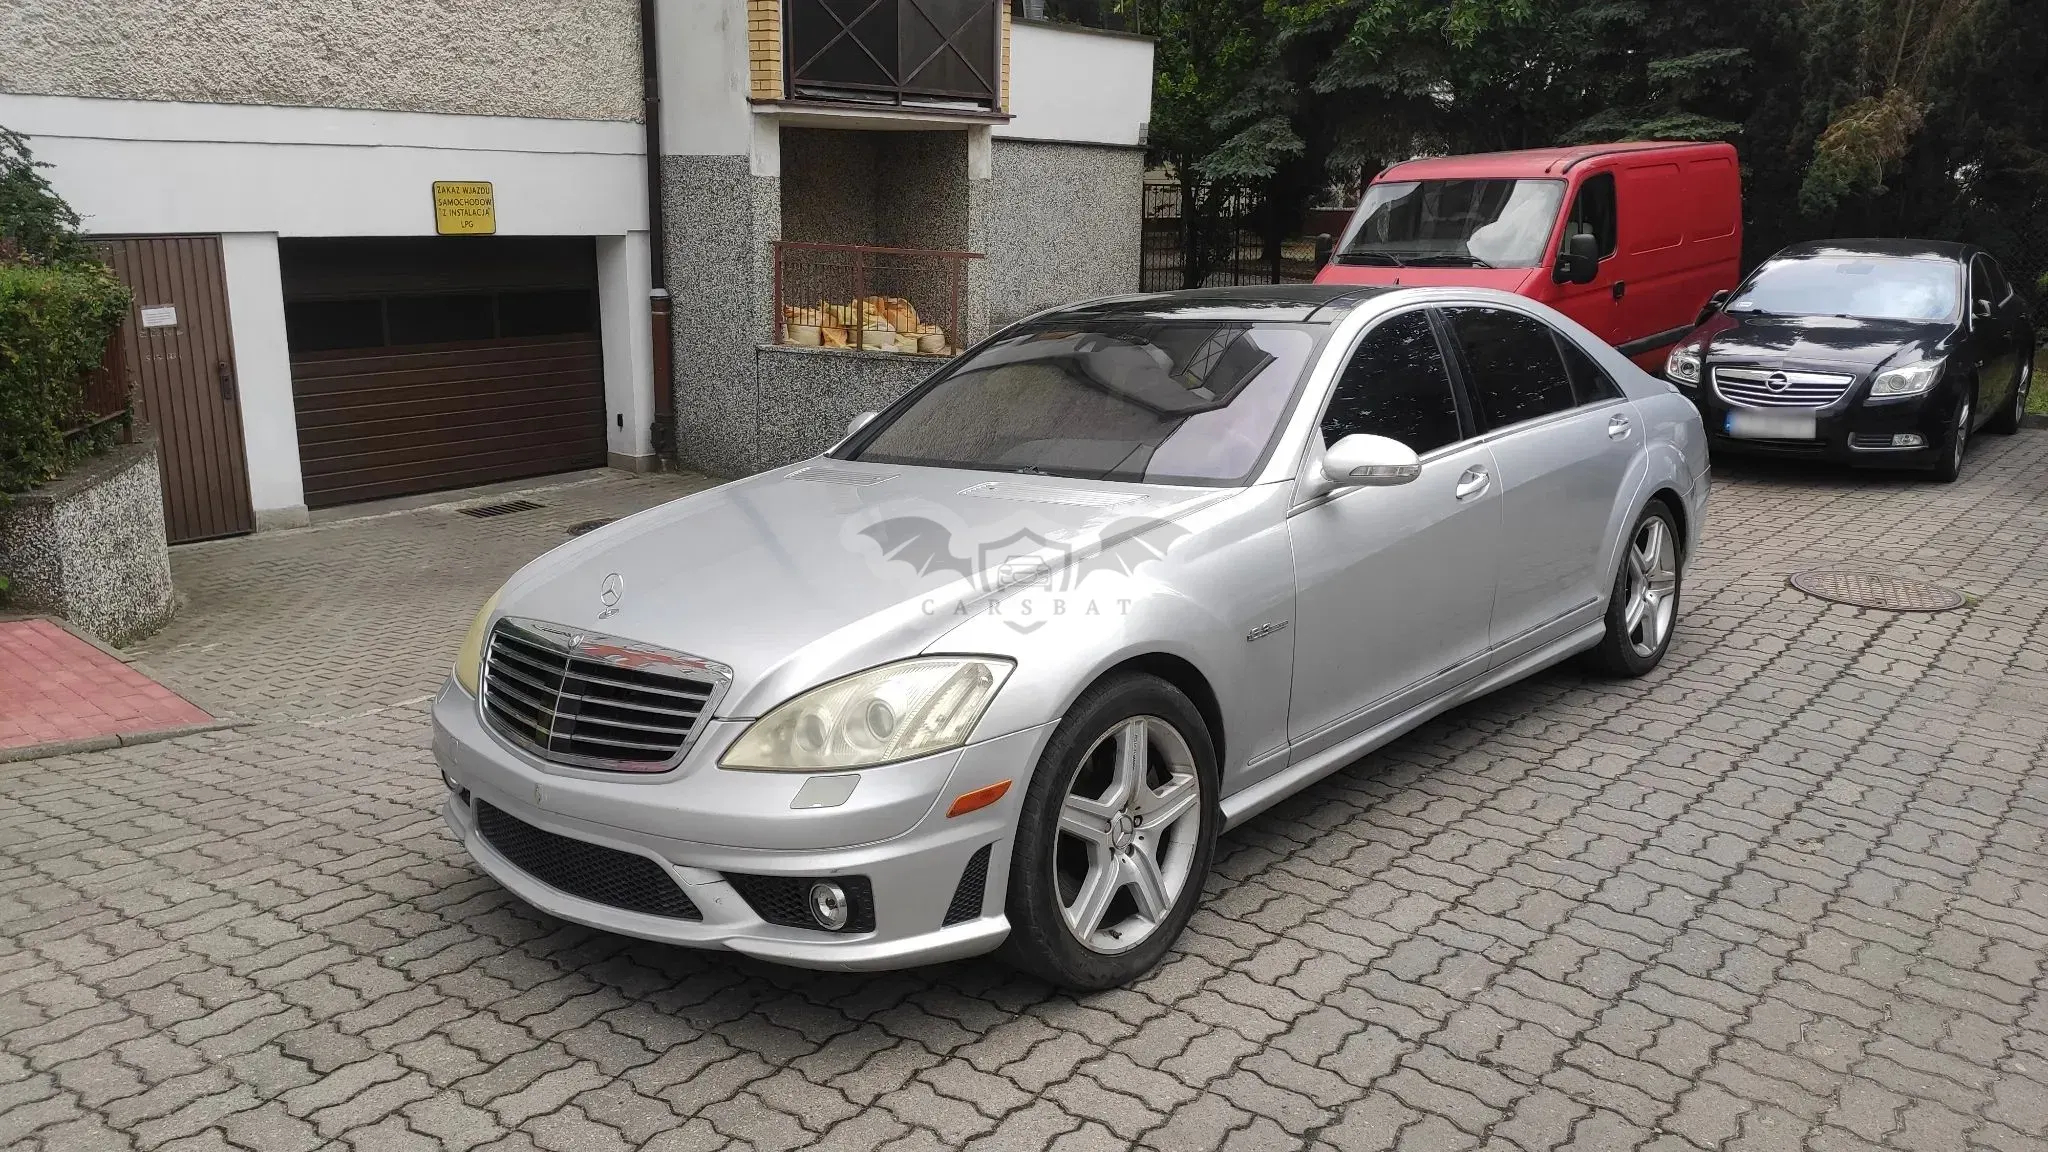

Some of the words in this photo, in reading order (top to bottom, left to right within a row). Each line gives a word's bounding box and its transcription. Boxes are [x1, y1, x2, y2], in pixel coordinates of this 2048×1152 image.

[437, 186, 460, 194] ZAKAZ
[462, 186, 490, 195] WJAZDU
[442, 209, 447, 217] Z
[461, 220, 474, 228] LPG
